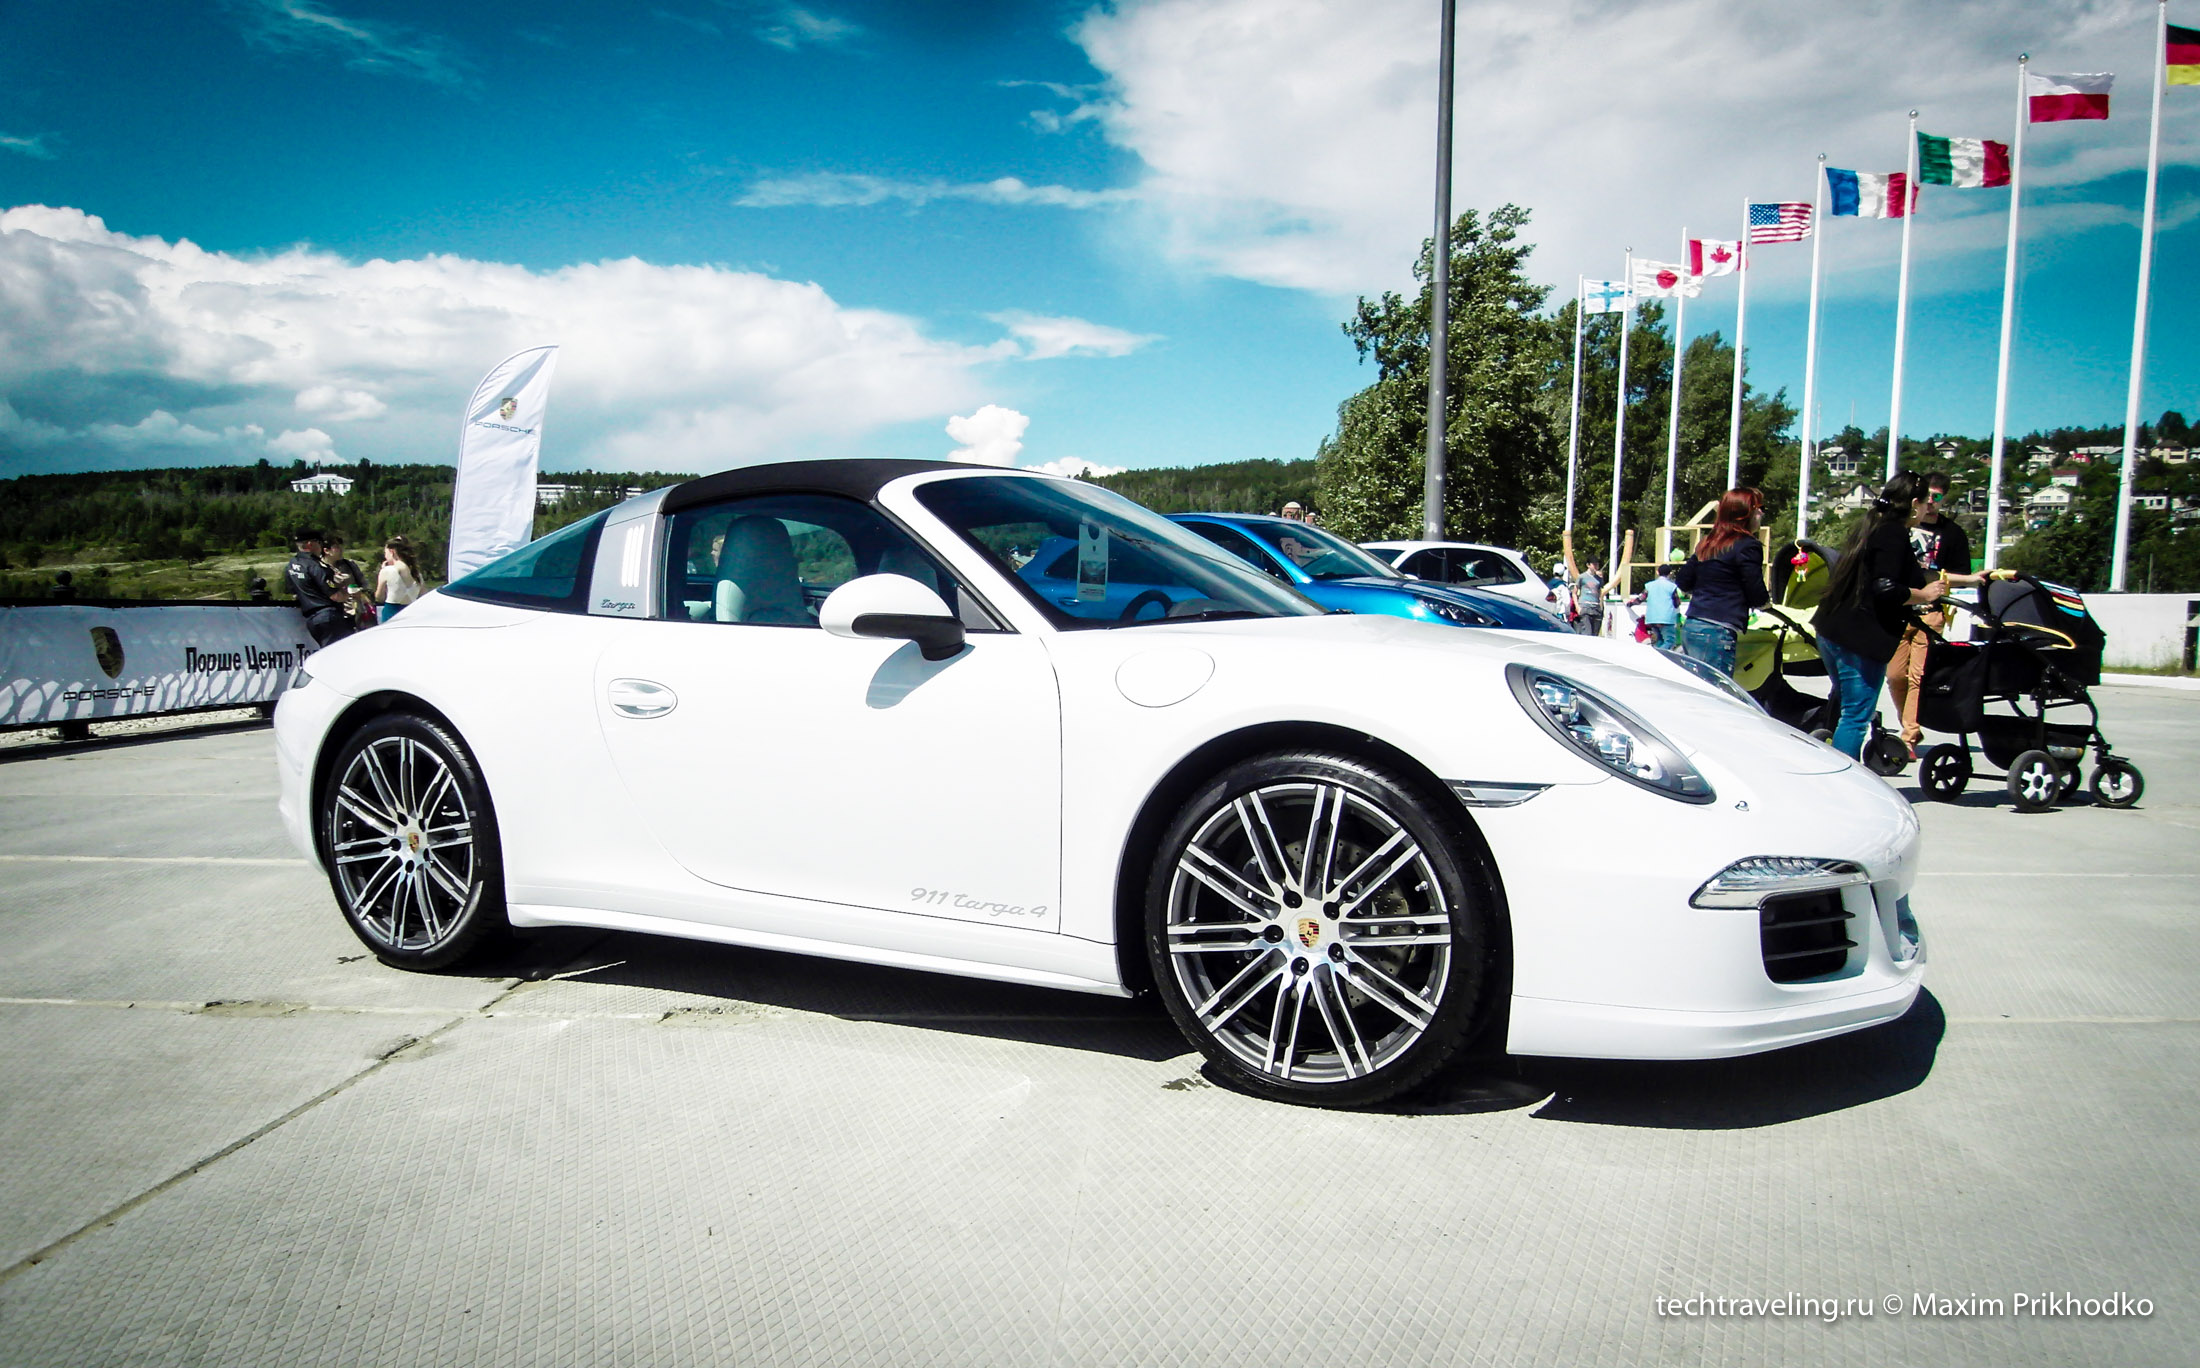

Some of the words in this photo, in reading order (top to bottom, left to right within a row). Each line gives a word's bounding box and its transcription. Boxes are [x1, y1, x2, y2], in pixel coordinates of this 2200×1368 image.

[185, 646, 241, 677] Порше
[245, 645, 293, 674] Центр
[63, 685, 155, 702] PORSCHE
[910, 887, 948, 904] 911
[1030, 905, 1048, 918] 4
